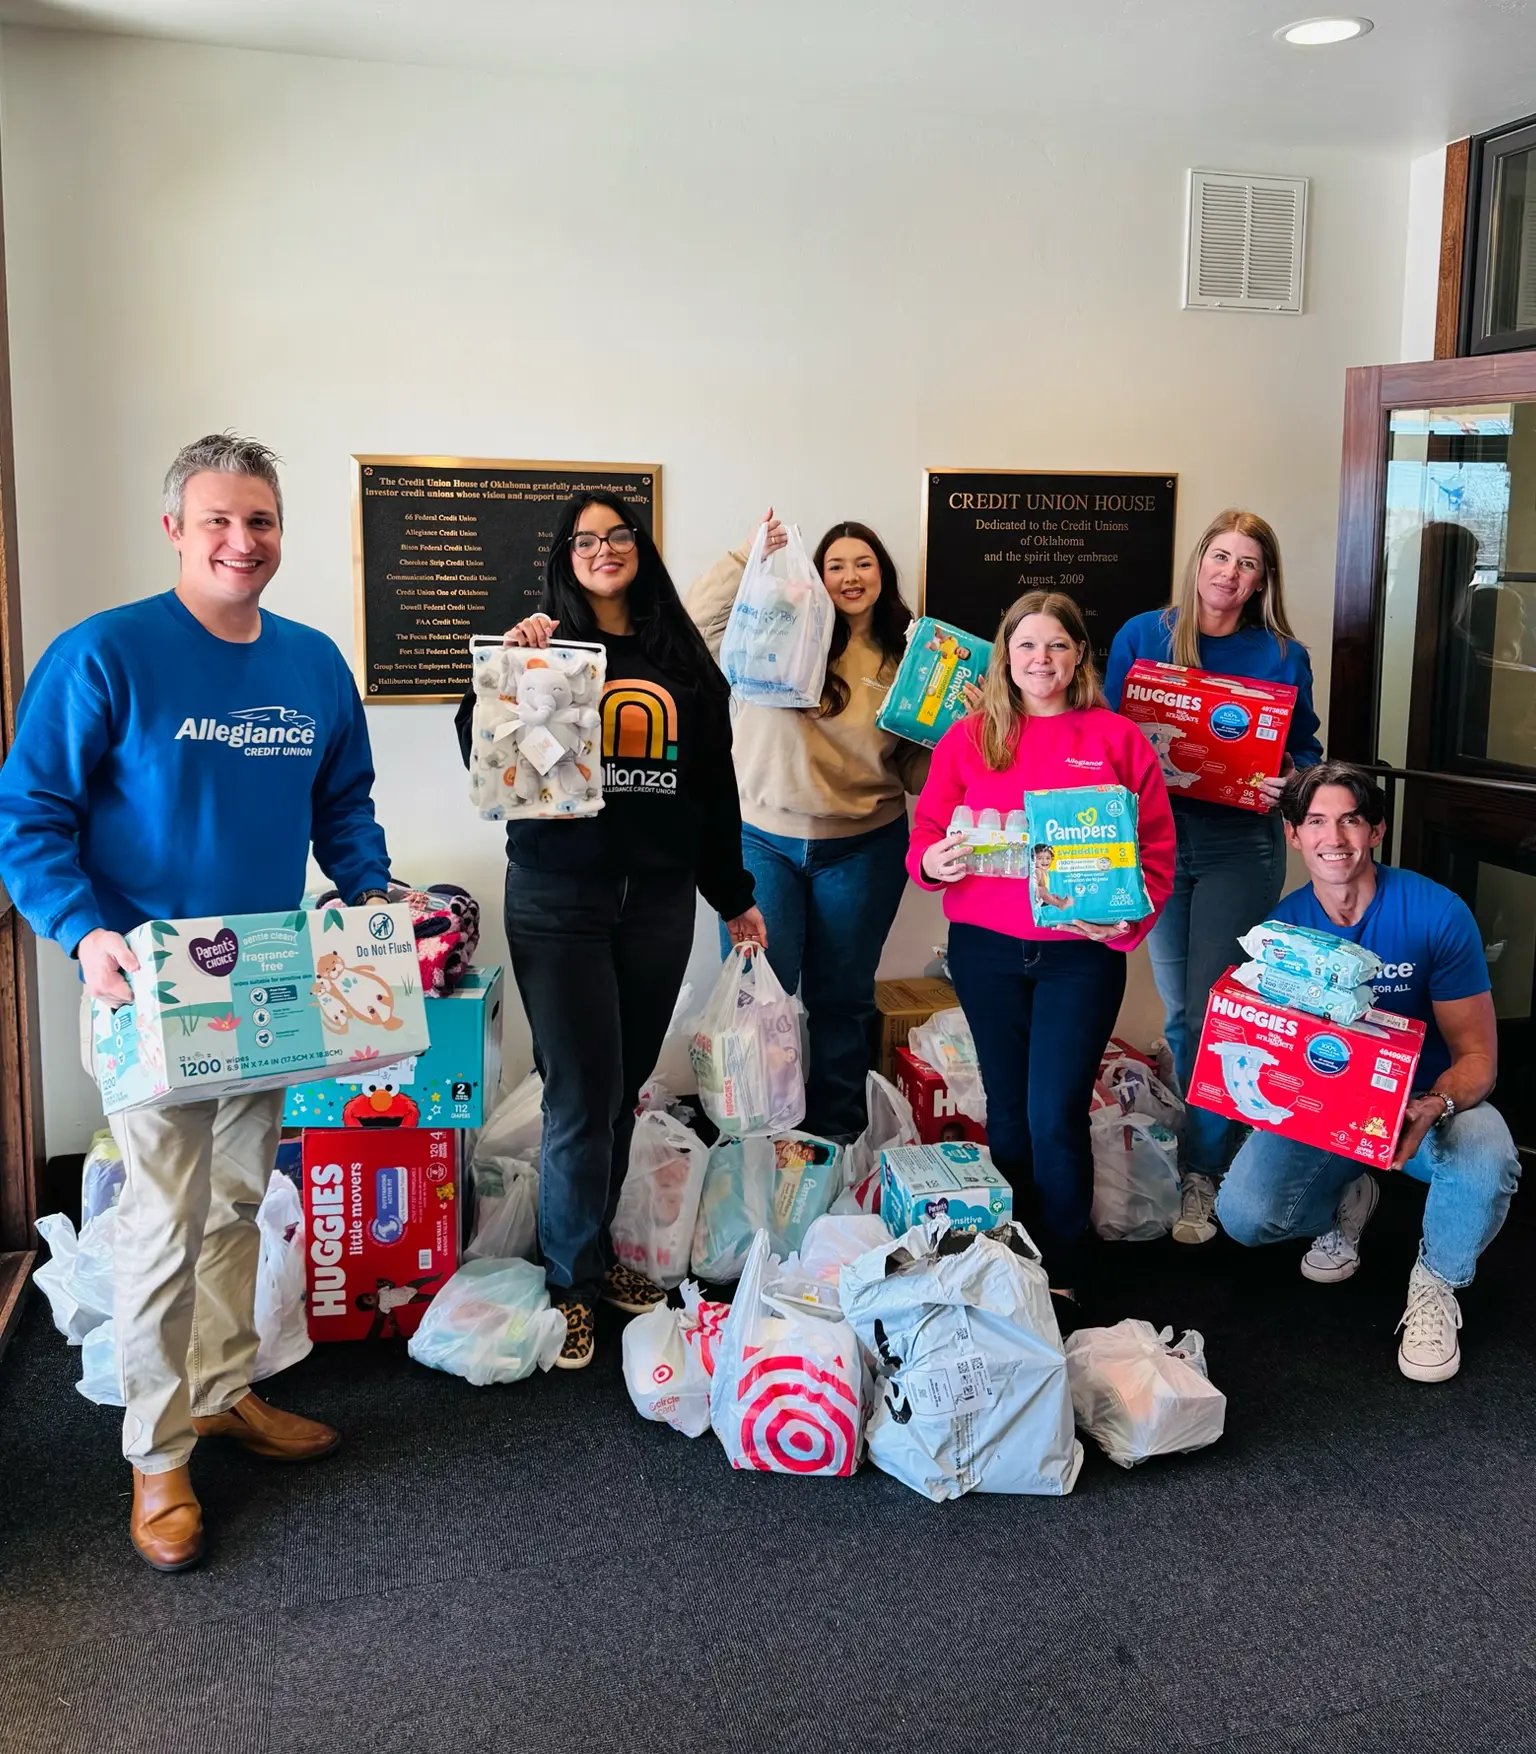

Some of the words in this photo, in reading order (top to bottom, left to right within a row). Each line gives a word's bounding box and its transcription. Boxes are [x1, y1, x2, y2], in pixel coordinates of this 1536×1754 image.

[379, 477, 396, 486] The
[398, 478, 424, 487] Credit
[427, 479, 451, 488] Union
[453, 479, 478, 488] House
[480, 480, 488, 488] of
[490, 480, 531, 490] Oklahoma
[532, 481, 570, 492] gratefully
[572, 482, 624, 493] acknowledges
[625, 484, 637, 492] the
[365, 488, 399, 496] Investor
[401, 489, 425, 497] credit
[427, 489, 455, 498] unions
[456, 490, 481, 499] whose
[482, 490, 505, 499] vision
[507, 491, 522, 500] and
[524, 493, 555, 502] support
[556, 493, 573, 501] mad
[623, 495, 650, 504] reality.
[949, 492, 1020, 510] CREDIT
[1026, 494, 1089, 511] UNION
[1094, 495, 1156, 512] HOUSE
[438, 514, 457, 522] Credit
[975, 519, 1026, 531] Dedicated
[1029, 520, 1039, 530] to
[1042, 519, 1058, 531] the
[1060, 519, 1091, 531] Credit
[1094, 519, 1129, 532] Unions
[405, 529, 437, 537] Allegiance
[439, 529, 458, 537] Credit
[1020, 535, 1031, 546] of
[1033, 535, 1084, 546] Oklahoma
[430, 559, 445, 568] Strip
[446, 559, 464, 567] Credit
[466, 559, 484, 567] Union
[984, 551, 1003, 562] and
[1005, 551, 1022, 562] the
[1024, 551, 1050, 564] spirit
[1053, 551, 1074, 564] they
[1077, 551, 1118, 562] embrace
[386, 573, 434, 582] Communication
[459, 574, 478, 582] Credit
[479, 574, 497, 582] Union
[1017, 574, 1057, 586] August,
[1059, 574, 1085, 585] 2009
[416, 589, 435, 597] Union
[458, 589, 488, 597] Oklahoma
[400, 603, 422, 611] Dowell
[423, 603, 446, 611] Federal
[447, 603, 465, 611] Credit
[432, 618, 451, 626] Credit
[452, 618, 470, 626] Union
[780, 610, 798, 626] Pay
[429, 632, 452, 640] Federal
[425, 647, 449, 655] Federal
[373, 663, 393, 671] Group
[418, 663, 450, 672] Employees
[378, 677, 414, 685] Halliburton
[414, 677, 446, 686] Employees
[944, 665, 972, 710] Pampers
[1126, 684, 1202, 711] HUGGIES
[174, 717, 315, 748] Allegiance
[244, 747, 280, 756] CREDIT
[283, 747, 312, 757] UNION
[601, 763, 677, 789] lianza
[1243, 789, 1254, 798] 96
[1045, 819, 1117, 844] Pampers
[1119, 847, 1126, 857] 3
[270, 930, 293, 942] clean
[195, 936, 235, 961] Parent's
[356, 945, 369, 957] Do
[371, 944, 387, 956] Not
[388, 941, 412, 954] Flush
[206, 953, 234, 969] CHOICE
[241, 949, 299, 963] fragrance-
[261, 962, 284, 972] free
[1373, 984, 1391, 993] FOR
[1393, 983, 1411, 993] ALL
[1211, 995, 1299, 1037] HUGGIES
[225, 1055, 249, 1065] wipes
[226, 1064, 239, 1072] 6.9
[241, 1062, 249, 1070] IN
[258, 1060, 269, 1068] 7.4
[281, 1054, 307, 1065] (17.5CM
[180, 1059, 221, 1077] 1200
[457, 1083, 465, 1095] 2
[454, 1104, 467, 1113] 112
[429, 1131, 444, 1140] 4
[1360, 1138, 1373, 1149] 84
[429, 1143, 439, 1158] 120
[1377, 1144, 1391, 1159] 2
[349, 1162, 363, 1218] movers
[311, 1163, 347, 1317] HUGGIES
[349, 1219, 363, 1255] little
[656, 1395, 680, 1408] circle
[657, 1404, 676, 1414] card
